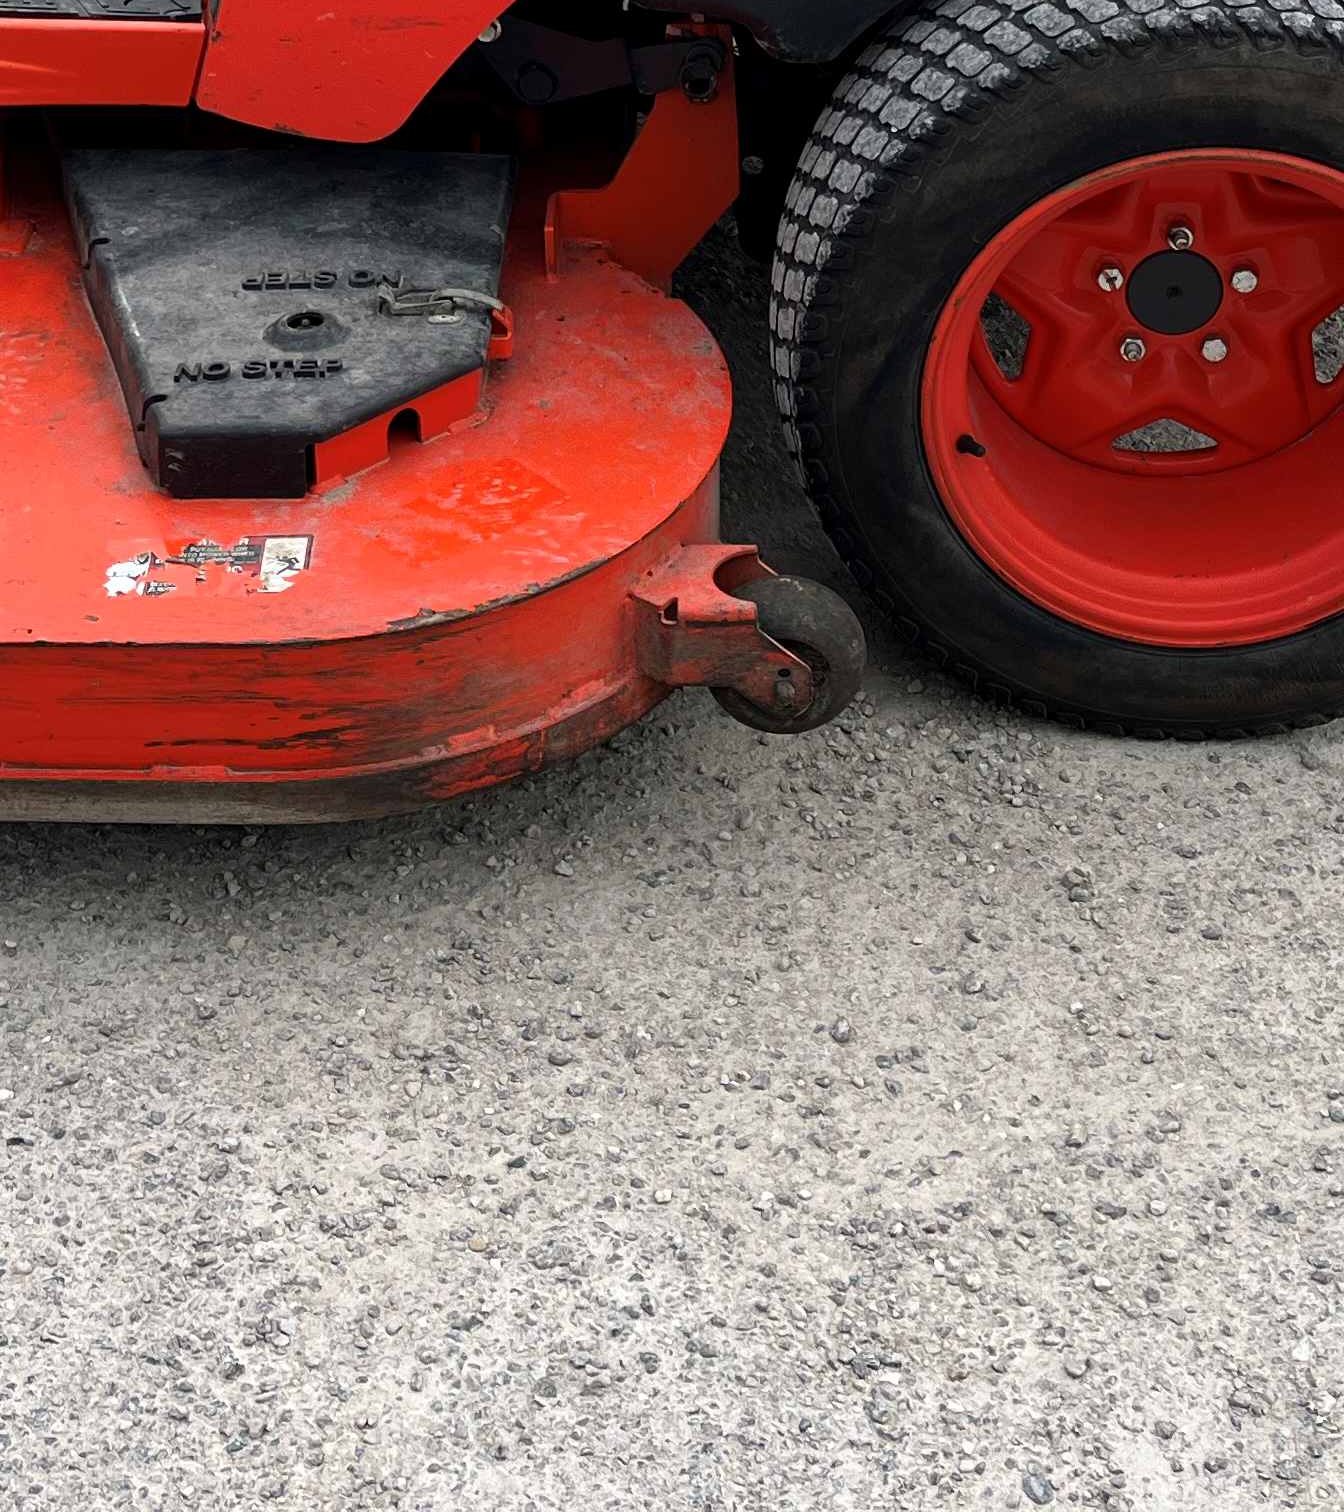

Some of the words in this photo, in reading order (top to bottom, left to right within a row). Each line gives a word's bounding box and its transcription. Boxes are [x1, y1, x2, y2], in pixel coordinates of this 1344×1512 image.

[241, 270, 338, 291] STEP
[348, 269, 404, 288] NO
[173, 362, 231, 384] NO
[241, 358, 344, 380] STEP
